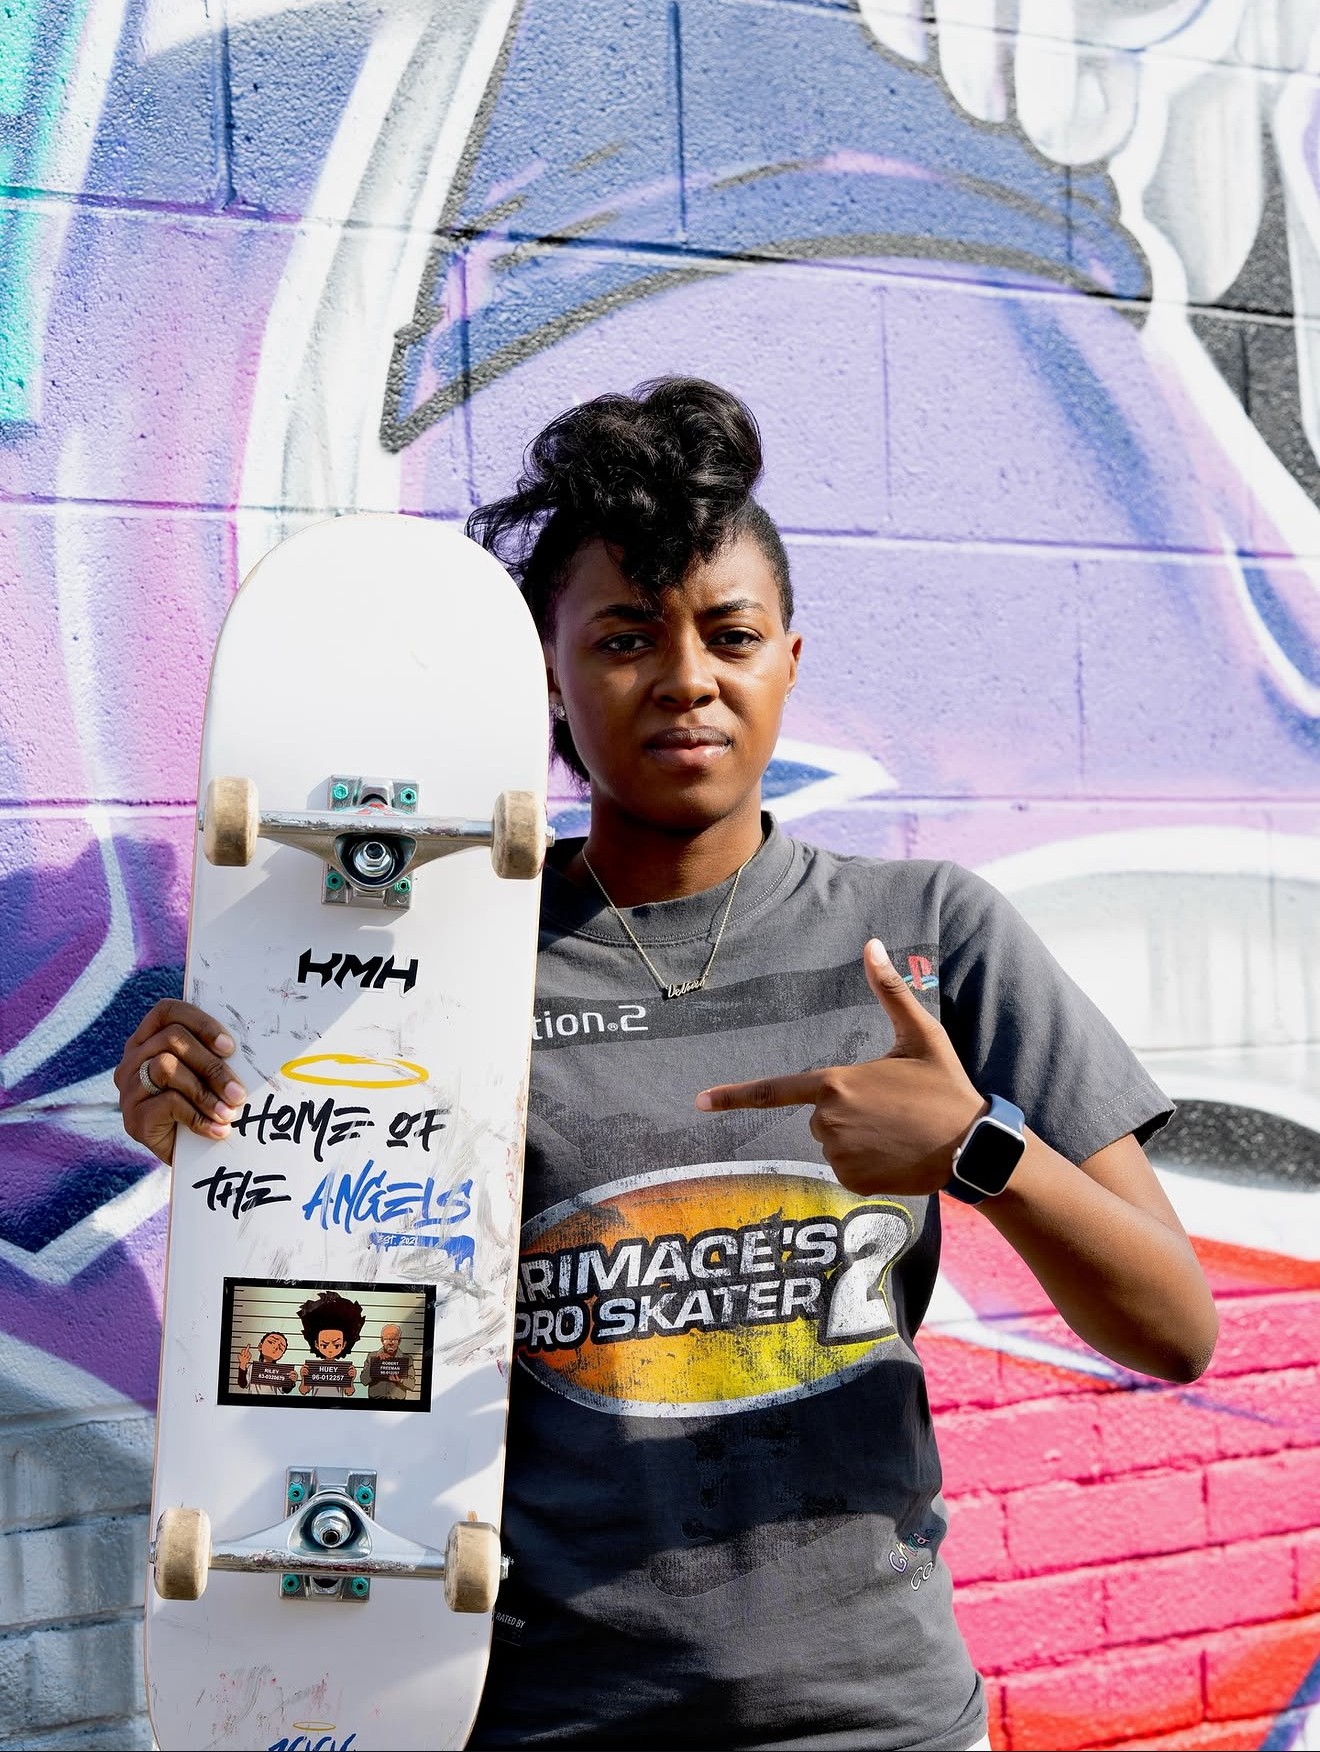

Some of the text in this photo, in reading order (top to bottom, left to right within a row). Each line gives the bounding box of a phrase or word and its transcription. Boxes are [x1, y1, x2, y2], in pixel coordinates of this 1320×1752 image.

[297, 948, 419, 993] KMH
[231, 1094, 450, 1162] HOME OF
[192, 1159, 474, 1233] THE ANGELS
[597, 1276, 822, 1337] SKATER
[826, 1211, 908, 1338] 2
[496, 1612, 526, 1629] RATED BY
